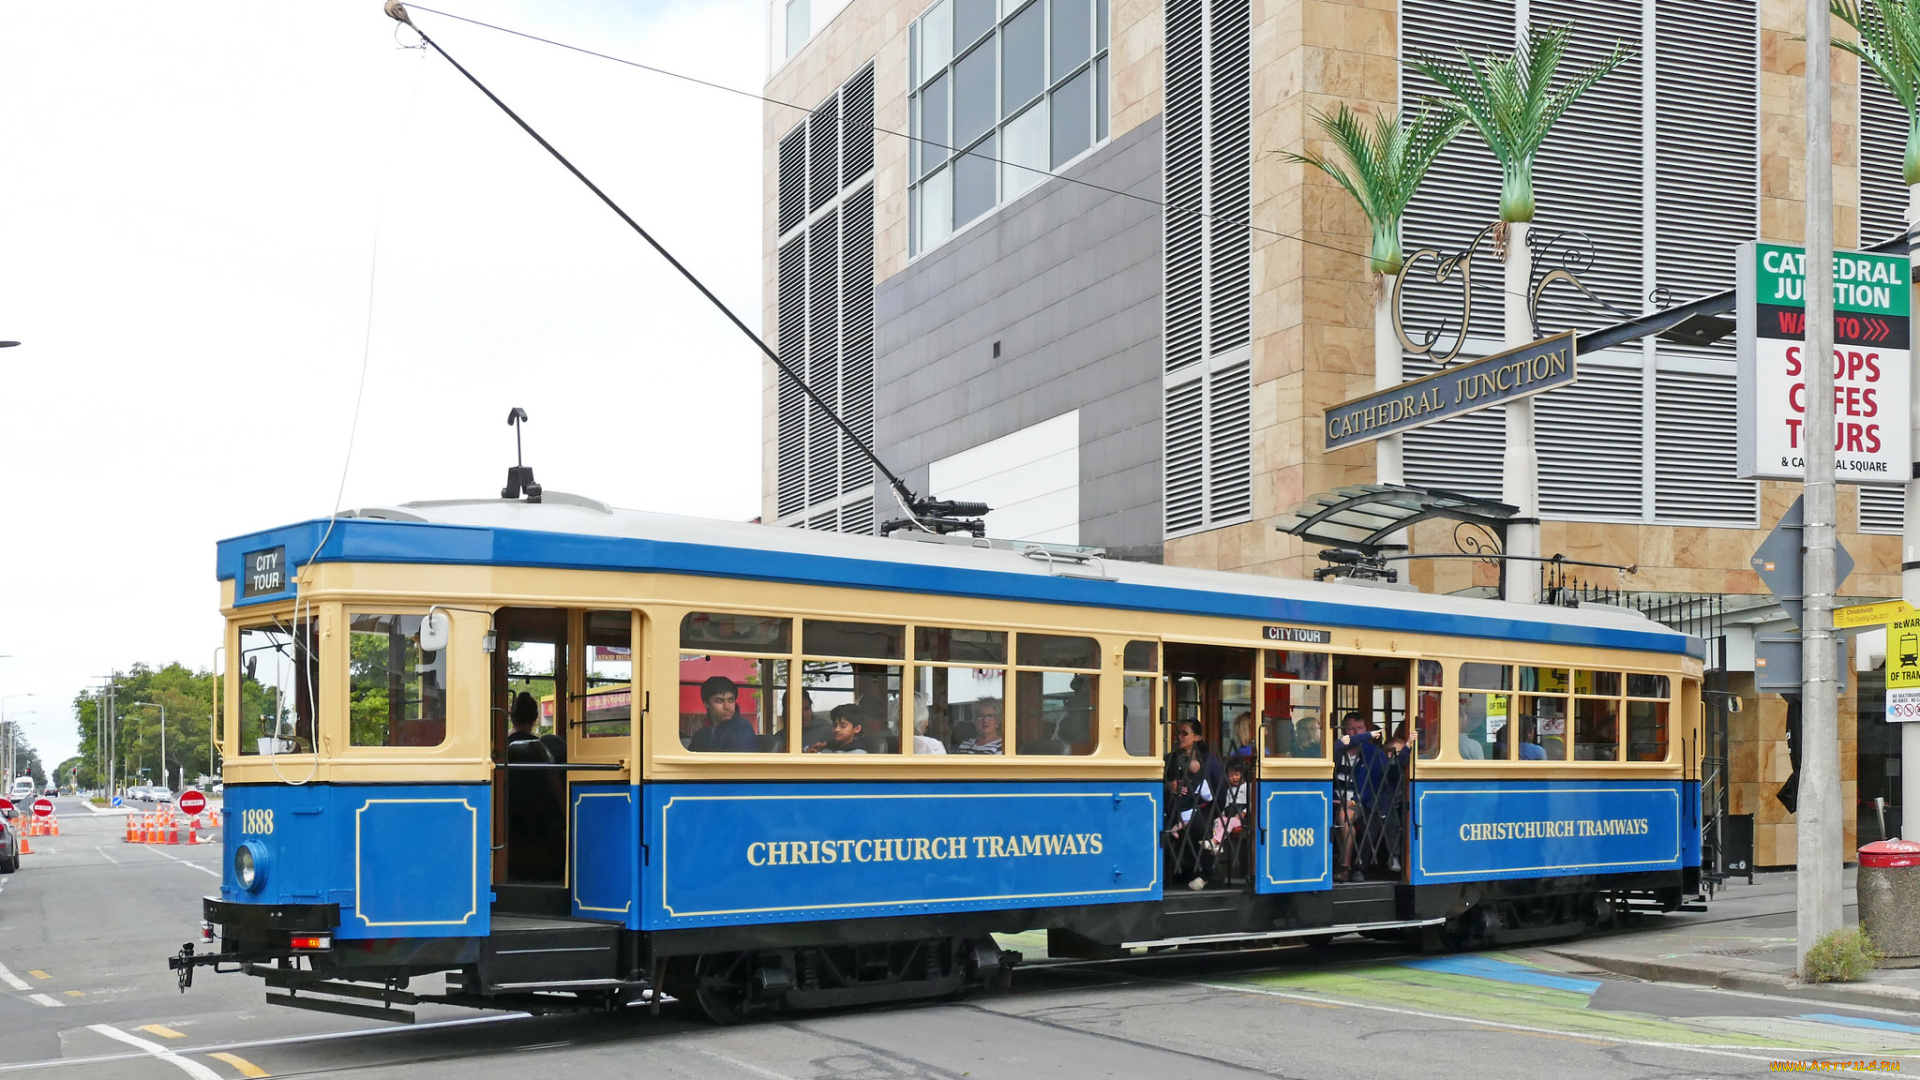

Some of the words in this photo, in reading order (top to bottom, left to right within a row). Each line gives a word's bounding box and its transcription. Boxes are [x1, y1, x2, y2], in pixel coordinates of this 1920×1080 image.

[1763, 251, 1902, 285] CATEDRAL
[1774, 278, 1890, 308] JUTION
[1778, 312, 1805, 335] WA
[1836, 317, 1860, 339] TO
[1786, 347, 1881, 382] SOPS
[1329, 387, 1445, 440] CATHEDRAL
[1455, 349, 1566, 404] JUNCTION
[1789, 383, 1878, 417] CFES
[1786, 419, 1881, 453] TURS
[1781, 456, 1789, 467] &
[1850, 460, 1887, 473] SQUARE
[256, 553, 278, 571] CITY
[253, 572, 279, 591] TOUR
[1269, 627, 1291, 640] CITY
[1293, 629, 1321, 642] TOUR
[1894, 618, 1920, 629] BEWAR
[1891, 672, 1900, 681] OF
[242, 809, 274, 835] 1888
[1460, 821, 1574, 841] CHRISTCHURCH
[1577, 818, 1648, 837] TRAMWAYS
[747, 836, 967, 866] CHRISTCHURCH
[973, 833, 1103, 859] TRAMWAYS
[1281, 827, 1314, 847] 1888
